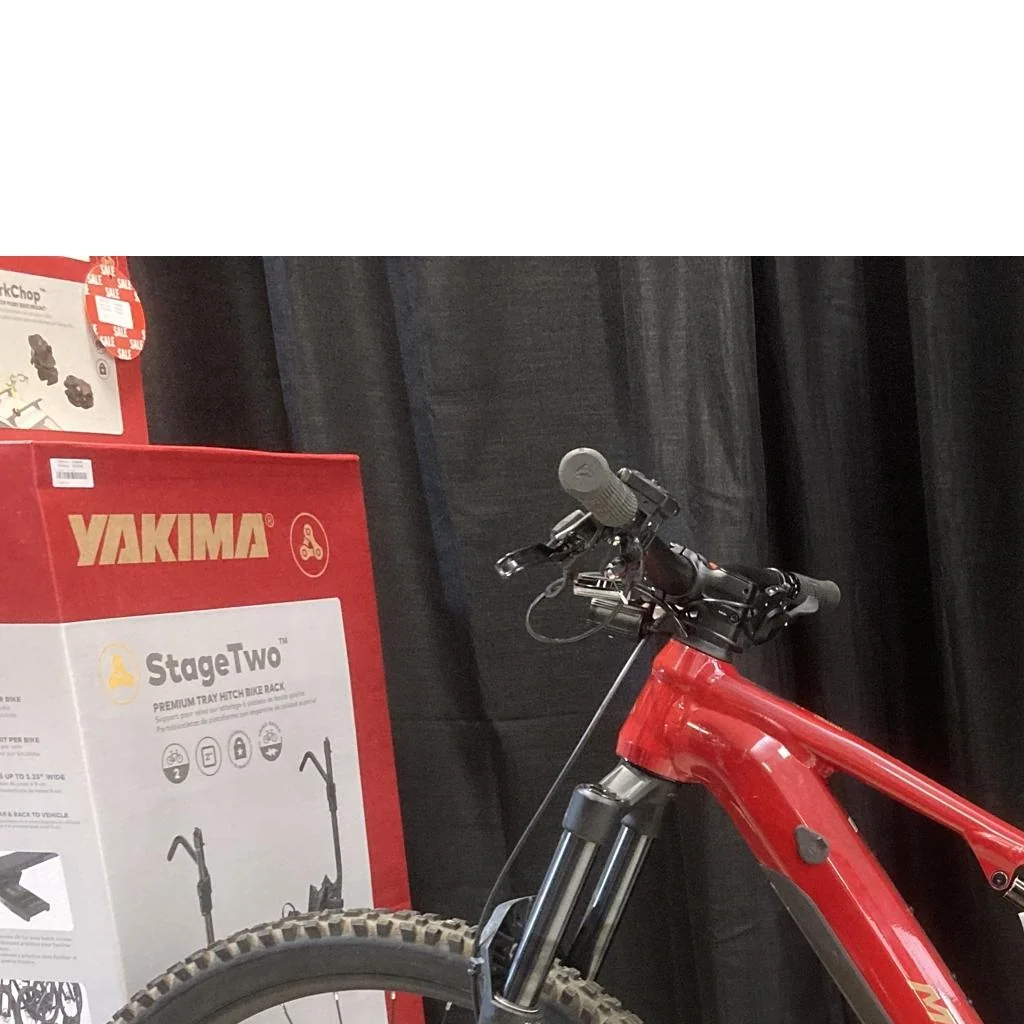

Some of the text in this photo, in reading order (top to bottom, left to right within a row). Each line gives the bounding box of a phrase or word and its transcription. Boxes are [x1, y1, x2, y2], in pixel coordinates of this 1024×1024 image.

[68, 513, 269, 567] YAKIMA
[153, 697, 196, 713] PREMIUM
[196, 692, 219, 705] TRAY
[220, 688, 244, 701] HITCH
[245, 685, 263, 697] BIKE
[264, 682, 286, 693] RACK
